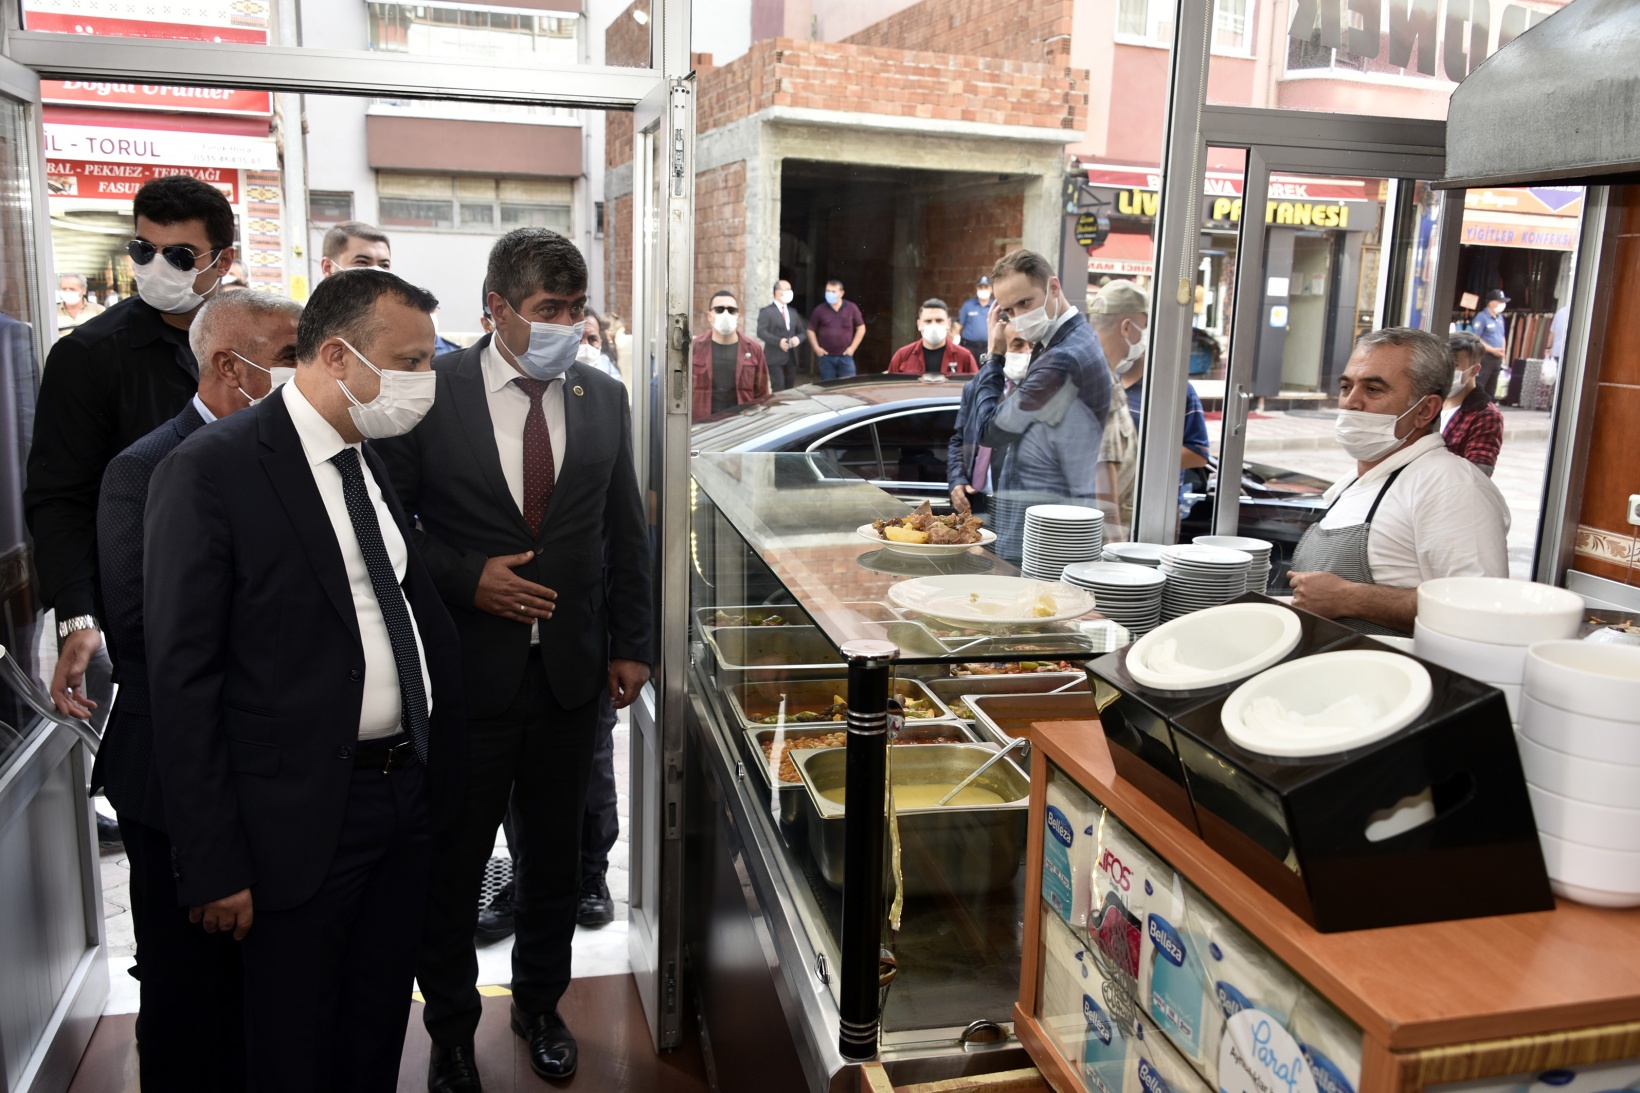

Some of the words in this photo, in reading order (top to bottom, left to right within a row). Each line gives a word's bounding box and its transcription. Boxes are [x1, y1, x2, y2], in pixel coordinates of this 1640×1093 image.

[86, 137, 160, 158] TORUL
[47, 163, 74, 175] BAL
[84, 165, 142, 178] PEKMEZ
[1119, 189, 1158, 216] LİV
[1047, 811, 1072, 844] Belleza
[1149, 921, 1183, 963] Belleza
[1084, 1001, 1111, 1041] Belleza
[1250, 1019, 1303, 1093] Paraf
